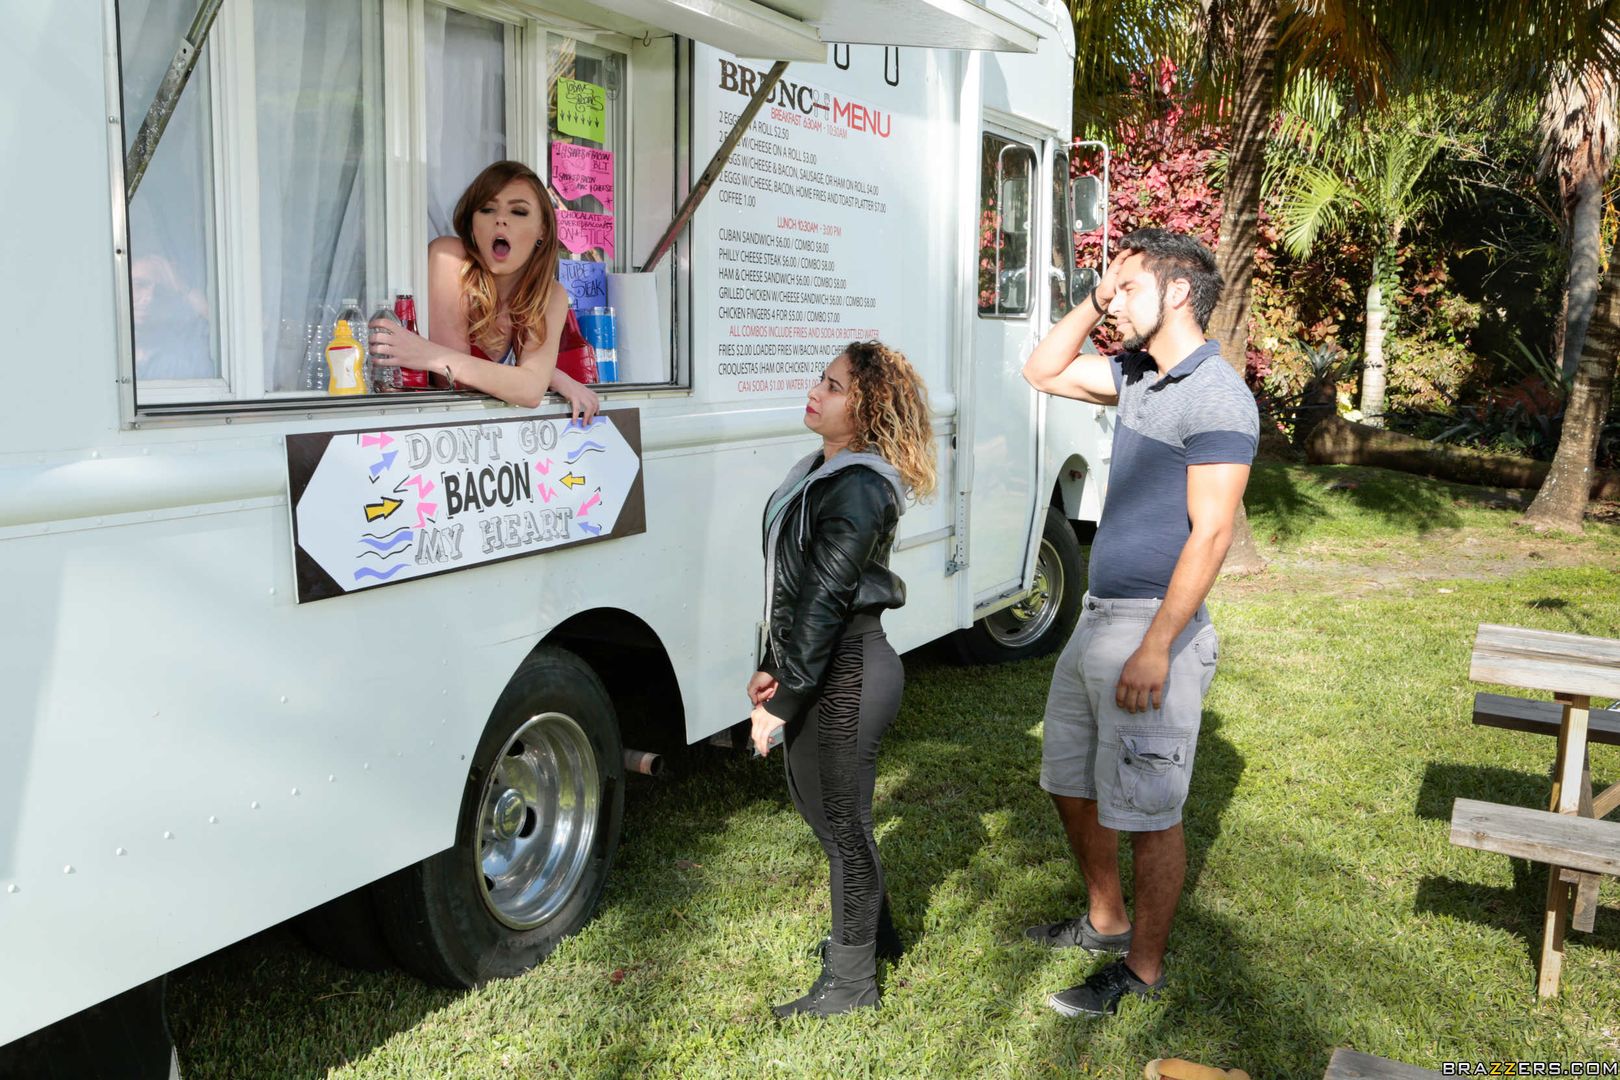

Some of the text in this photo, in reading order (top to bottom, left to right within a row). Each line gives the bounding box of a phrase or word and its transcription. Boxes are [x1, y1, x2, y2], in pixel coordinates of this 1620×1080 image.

[771, 107, 801, 126] BREAKFAST
[833, 97, 891, 138] MENU
[758, 121, 773, 136] ROLL
[774, 125, 790, 140] $2.50
[773, 144, 782, 156] ON
[788, 148, 802, 161] ROLL
[803, 152, 817, 165] $3.00
[593, 160, 609, 171] BLT
[728, 153, 741, 166] GGS
[825, 174, 833, 185] OR
[833, 176, 846, 189] HAM
[846, 179, 854, 191] ON
[854, 181, 866, 194] ROLL
[867, 184, 880, 196] $4.00
[719, 190, 756, 207] COFFEE 1.00
[724, 170, 741, 185] EGGS
[796, 186, 812, 200] HOME
[813, 188, 826, 202] FRIES
[827, 192, 839, 205] AND
[839, 194, 854, 208] TOAST
[854, 197, 874, 212] PLATTER
[874, 201, 887, 214] $7.00
[559, 227, 574, 241] ON
[777, 216, 797, 230] LUNCH
[833, 226, 842, 237] PM
[719, 228, 741, 242] CUBAN
[742, 231, 775, 247] SANDWICH
[776, 236, 791, 249] $6.00
[794, 238, 815, 252] COMBO
[815, 241, 830, 254] $8.00
[719, 247, 740, 262] PHILLY
[740, 250, 763, 265] CHEESE
[764, 253, 781, 266] STEAK
[782, 256, 797, 268] $6.00
[801, 257, 821, 271] COMBO
[562, 262, 591, 281] TUBE
[719, 267, 734, 280] HAM
[735, 268, 740, 281] &
[740, 269, 763, 283] CHEESE
[763, 271, 795, 285] SANDWICH
[796, 274, 810, 287] $6.00
[814, 275, 833, 289] COMBO
[571, 279, 605, 298] STEAK
[719, 286, 745, 300] GRILLED
[745, 288, 771, 302] CHICKEN
[801, 291, 829, 306] SANDWICH
[829, 294, 843, 307] $6.00
[845, 295, 864, 308] COMBO
[719, 306, 746, 319] CHICKEN
[746, 307, 771, 321] FINGERS
[776, 309, 788, 321] FOR
[788, 310, 804, 322] $5.00
[807, 310, 826, 323] COMBO
[827, 312, 840, 323] $7.00
[729, 325, 741, 337] ALL
[741, 325, 768, 337] COMBOS
[768, 326, 793, 338] INCLUDE
[793, 326, 808, 338] FRIES
[809, 327, 820, 339] AND
[820, 327, 835, 339] SODA
[836, 328, 843, 339] OR
[843, 328, 865, 340] BOTTLED
[719, 344, 735, 356] FRIES
[736, 344, 753, 356] $2.00
[753, 344, 777, 356] LOADED
[778, 344, 793, 356] FRIES
[819, 344, 831, 356] AND
[718, 362, 758, 376] CROQUESTAS
[776, 362, 784, 374] OR
[814, 361, 825, 373] FOR
[737, 380, 752, 393] CAN
[752, 380, 769, 392] SODA
[769, 379, 785, 391] $1.00
[785, 378, 804, 391] WATER
[404, 420, 558, 469] DON'T GO
[441, 461, 533, 520] BACON
[414, 507, 573, 565] MY HEART
